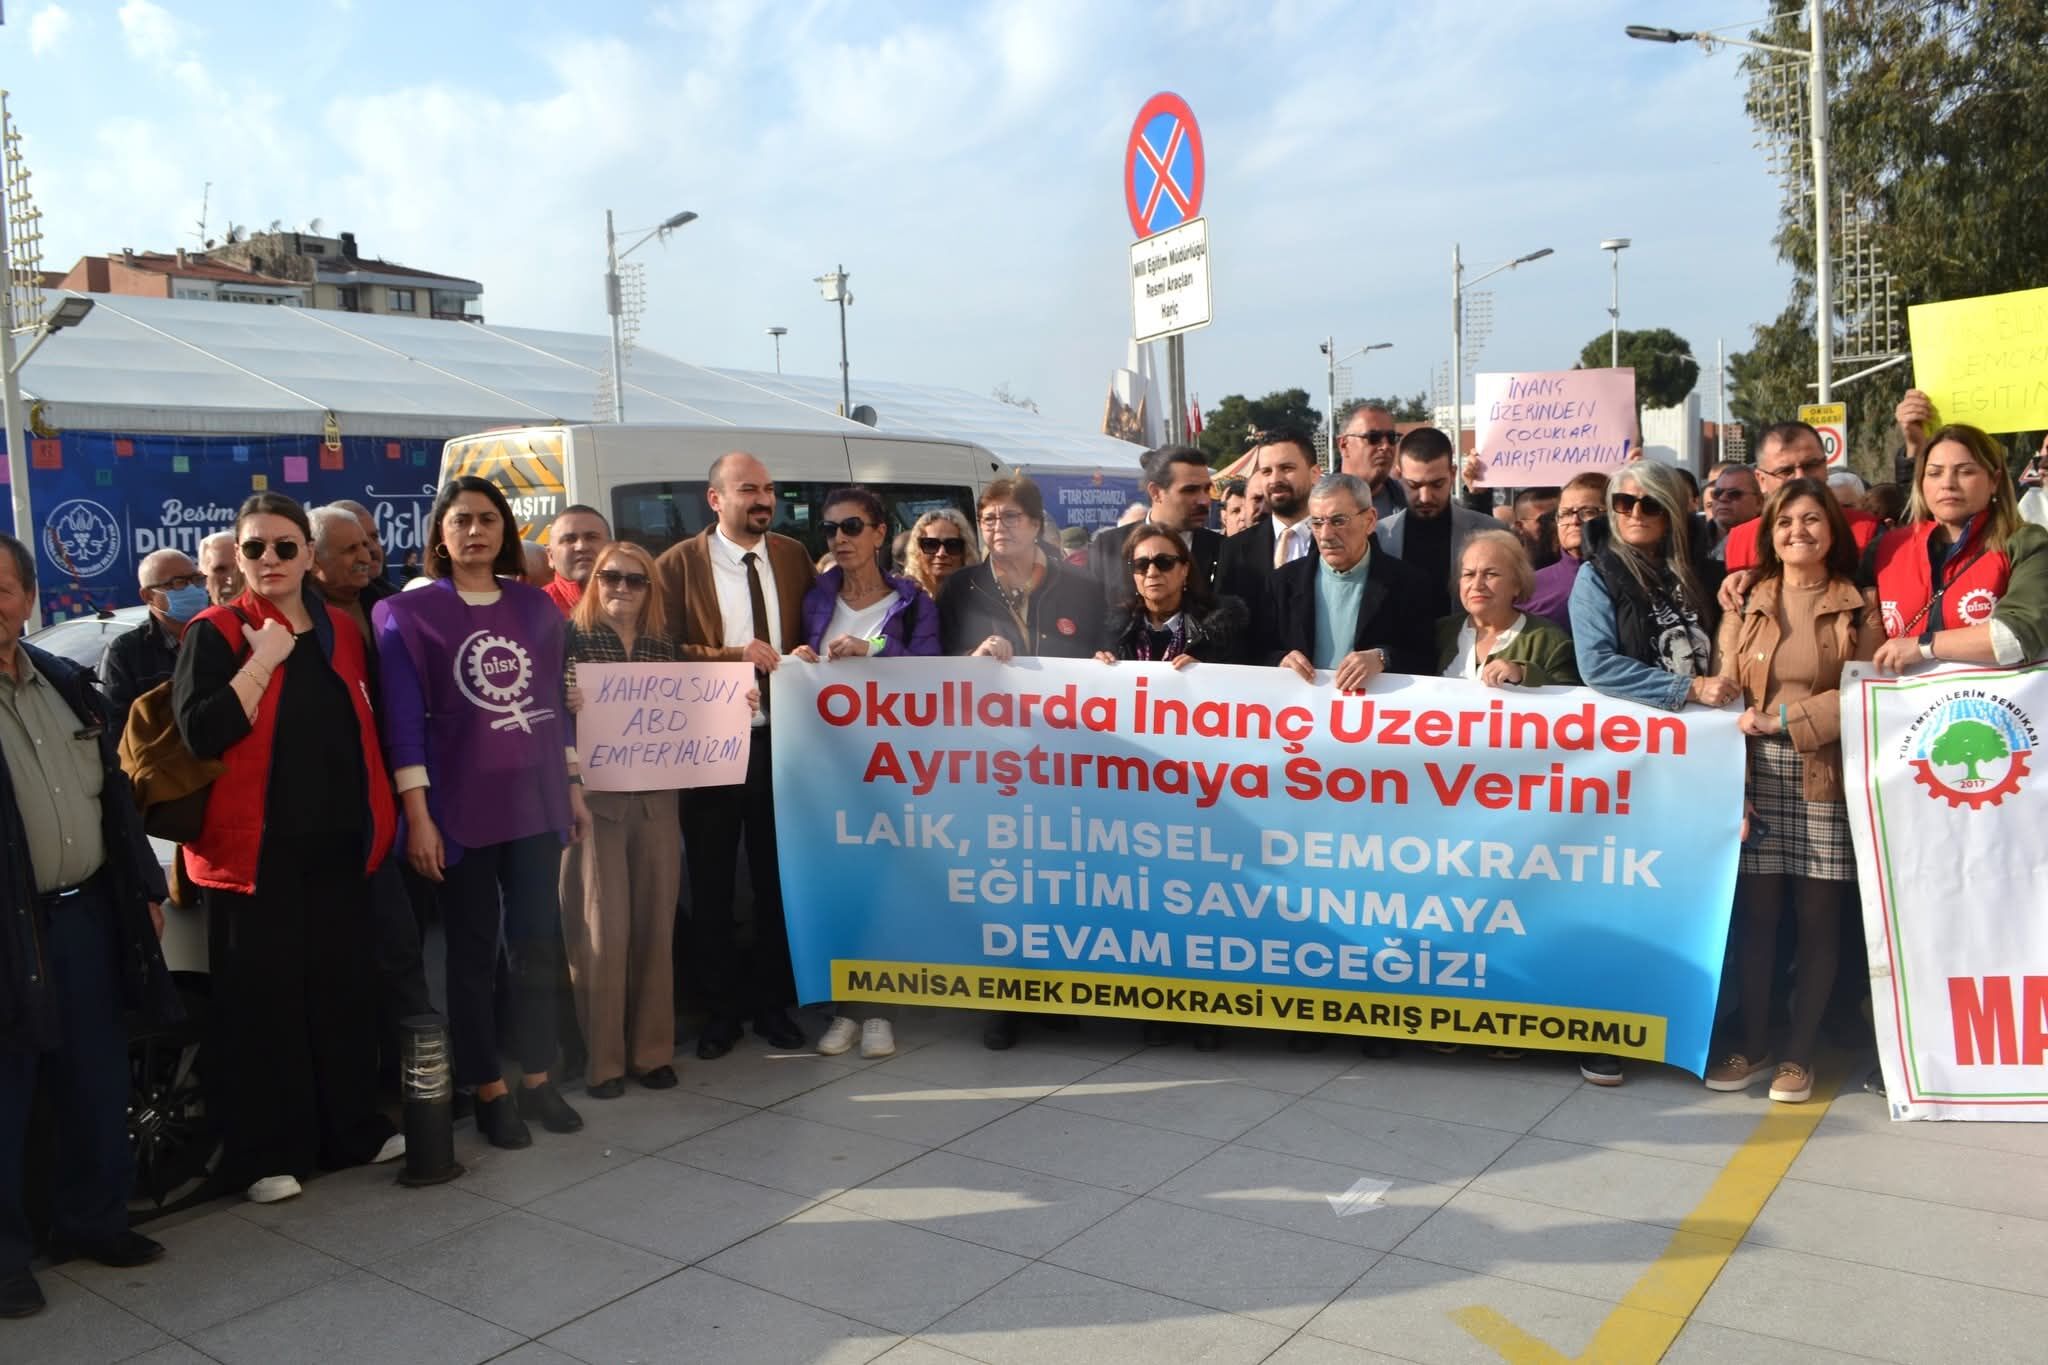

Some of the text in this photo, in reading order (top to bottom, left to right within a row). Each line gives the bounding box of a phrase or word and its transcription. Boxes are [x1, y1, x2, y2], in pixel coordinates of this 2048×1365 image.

[1146, 278, 1165, 298] Resmi
[1161, 300, 1179, 320] Hariç
[1505, 424, 1599, 446] ÇOCUKLARI
[1491, 439, 1631, 472] AYRIŞTIRMAYIN!
[160, 499, 238, 526] Besim
[595, 672, 739, 704] KAHROLSUN
[622, 708, 688, 736] ABD
[817, 676, 1687, 755] Okullarda İnanç Üzerinden
[863, 742, 1631, 815] Ayrıştırmaya Son Verin!
[1960, 780, 1986, 789] 2017
[834, 804, 1664, 888] LAİK, BİLİMSEL, DEMOKRATİK
[948, 858, 1527, 935] EĞİTİMİ SAVUNMAYA
[982, 923, 1487, 988] DEVAM EDECEĞİZ!
[847, 968, 1647, 1047] MANİSA EMEK DEMOKRASİ VE BARIŞ PLATFORMU
